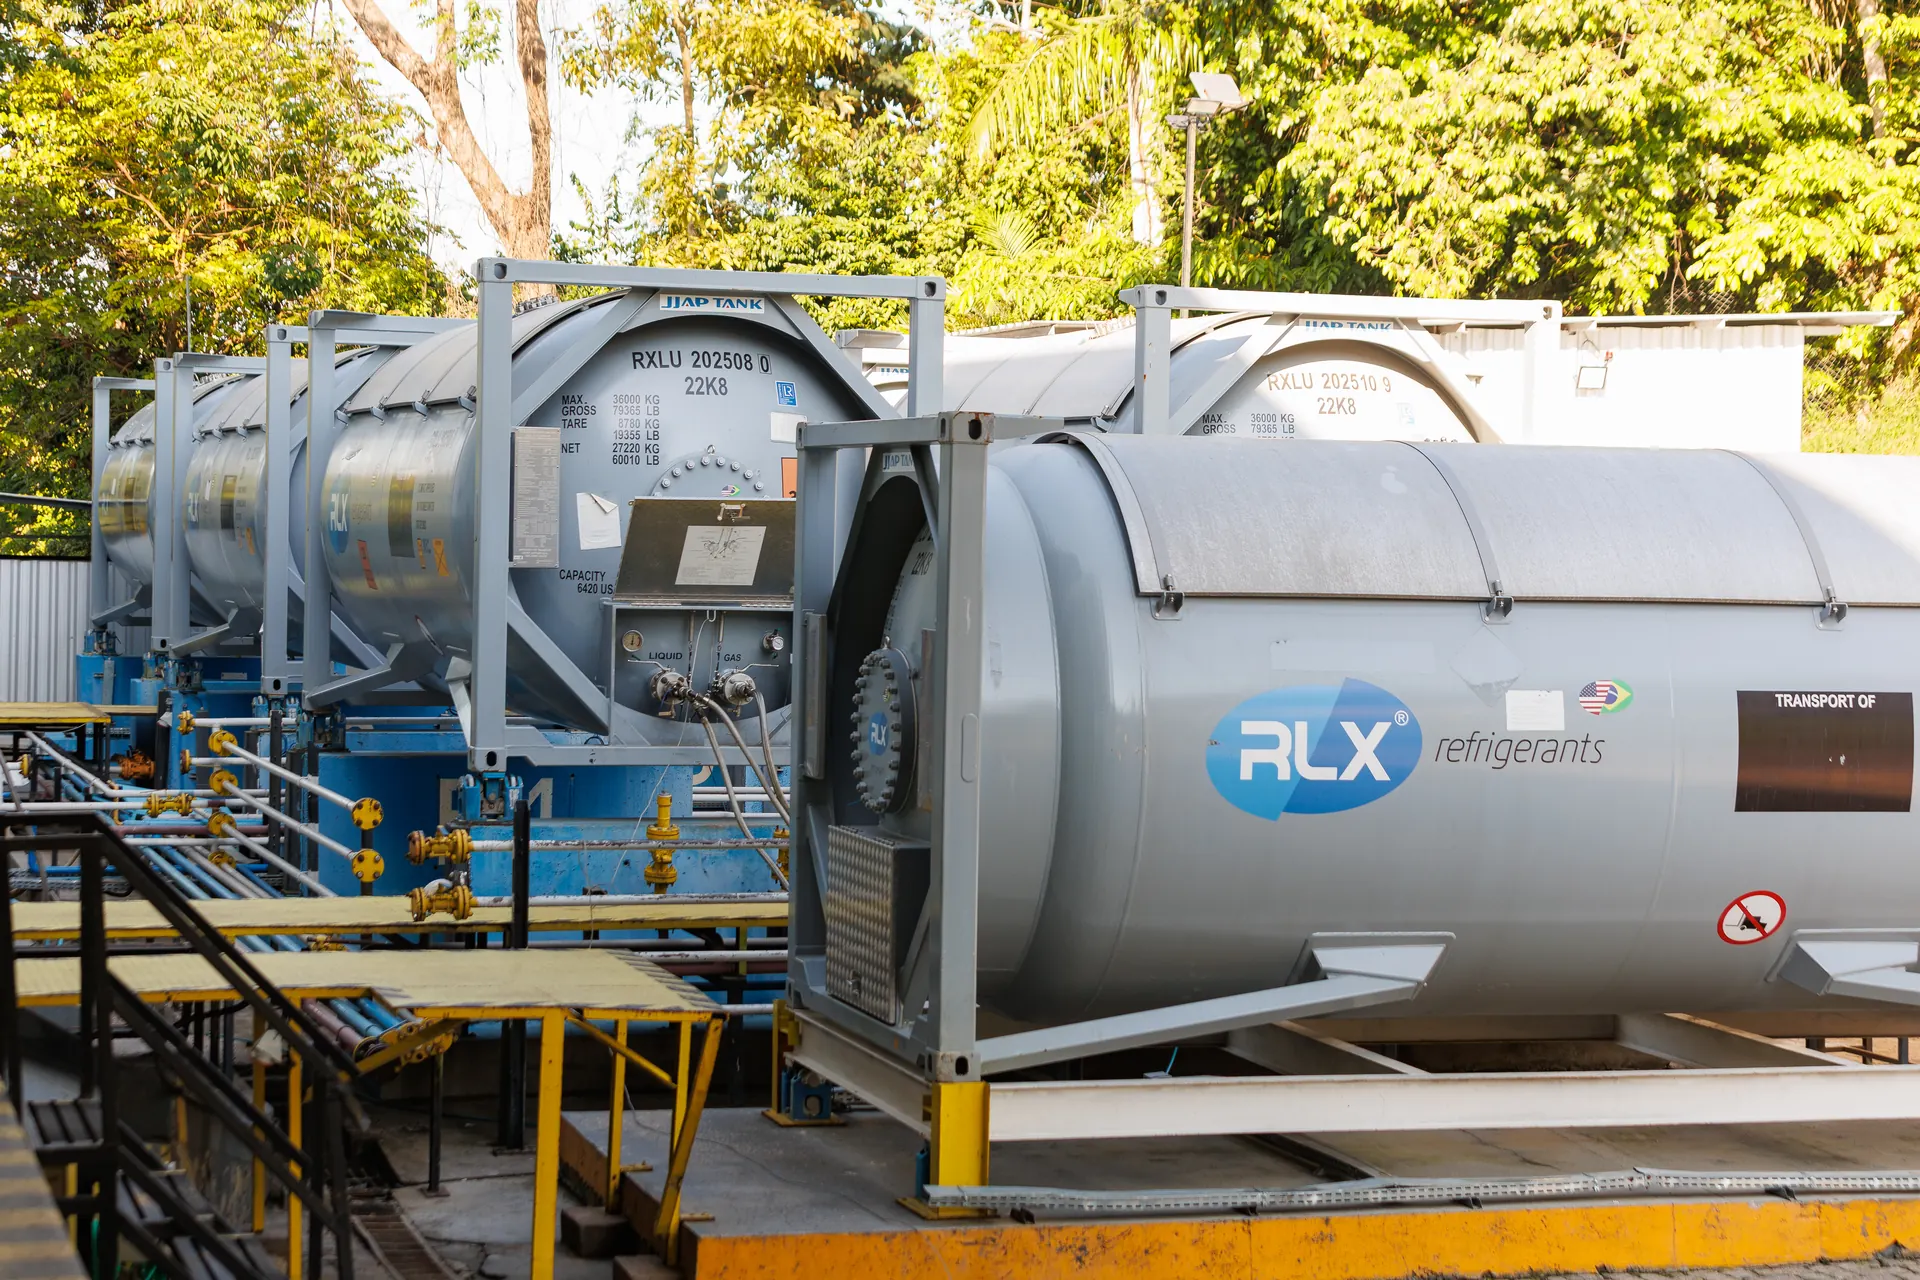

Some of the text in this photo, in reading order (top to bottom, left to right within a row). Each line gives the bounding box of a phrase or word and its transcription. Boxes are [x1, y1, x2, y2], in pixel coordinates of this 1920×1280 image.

[661, 296, 762, 310] JJAP TANK
[631, 350, 682, 370] RXLU
[691, 350, 753, 371] 202508
[684, 376, 728, 396] 22K8
[1266, 372, 1392, 393] RXLU 202510 9
[561, 394, 660, 405] MAX. 36000 KG
[561, 405, 660, 416] GROSS 79365 LB
[1316, 397, 1357, 415] 22K8
[562, 418, 660, 430] TARE 8780 KG
[1202, 413, 1295, 424] MAX. 36000 KG
[613, 430, 660, 441] 19355 LB
[1202, 424, 1295, 435] GROSS 79365 LB
[561, 443, 660, 455] NET 27220 KG
[612, 454, 660, 466] 60010 LB
[559, 569, 606, 582] CAPACITY
[577, 582, 598, 594] 6420
[648, 652, 742, 662] LIQUID GAS
[1774, 693, 1876, 709] TRANSPORT OF
[871, 722, 887, 747] RLX
[1239, 720, 1605, 781] RLX refrigerants
